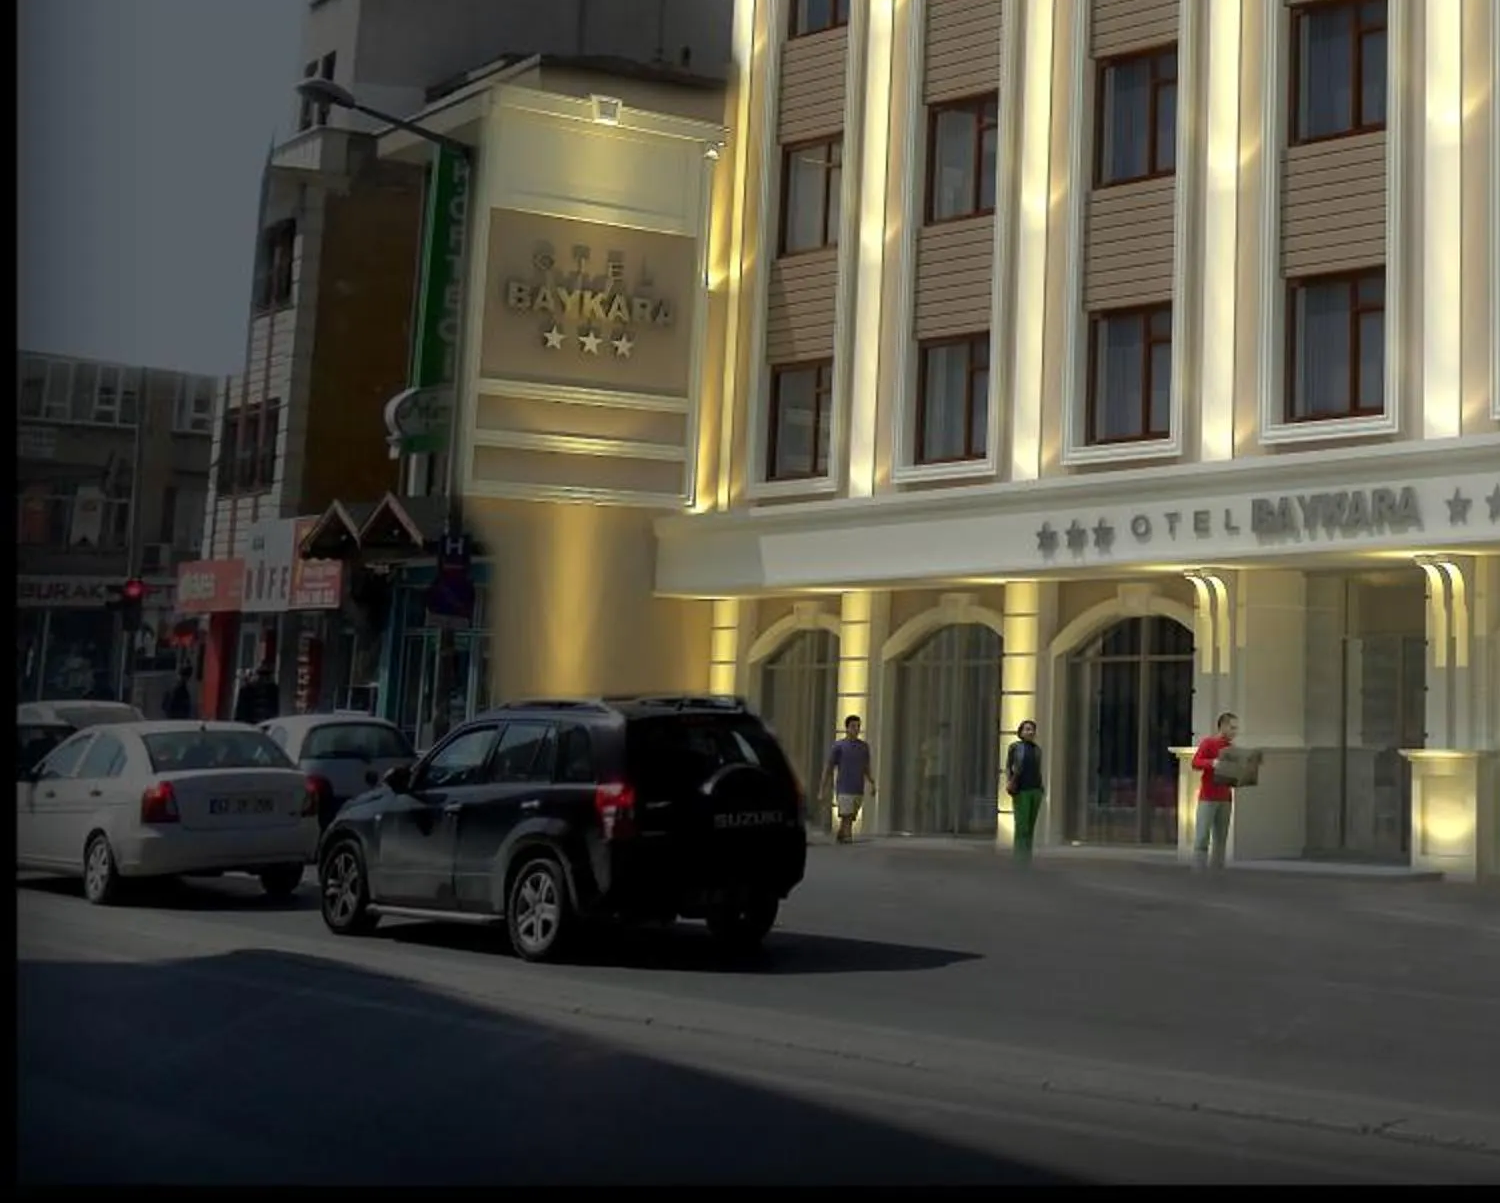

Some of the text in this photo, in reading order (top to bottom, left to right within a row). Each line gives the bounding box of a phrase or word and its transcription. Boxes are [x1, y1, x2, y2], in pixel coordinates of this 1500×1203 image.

[507, 281, 676, 325] BAYKARA
[1131, 486, 1424, 543] OTEL BAYKARA
[446, 537, 464, 555] H
[713, 810, 783, 829] SUZUKI
